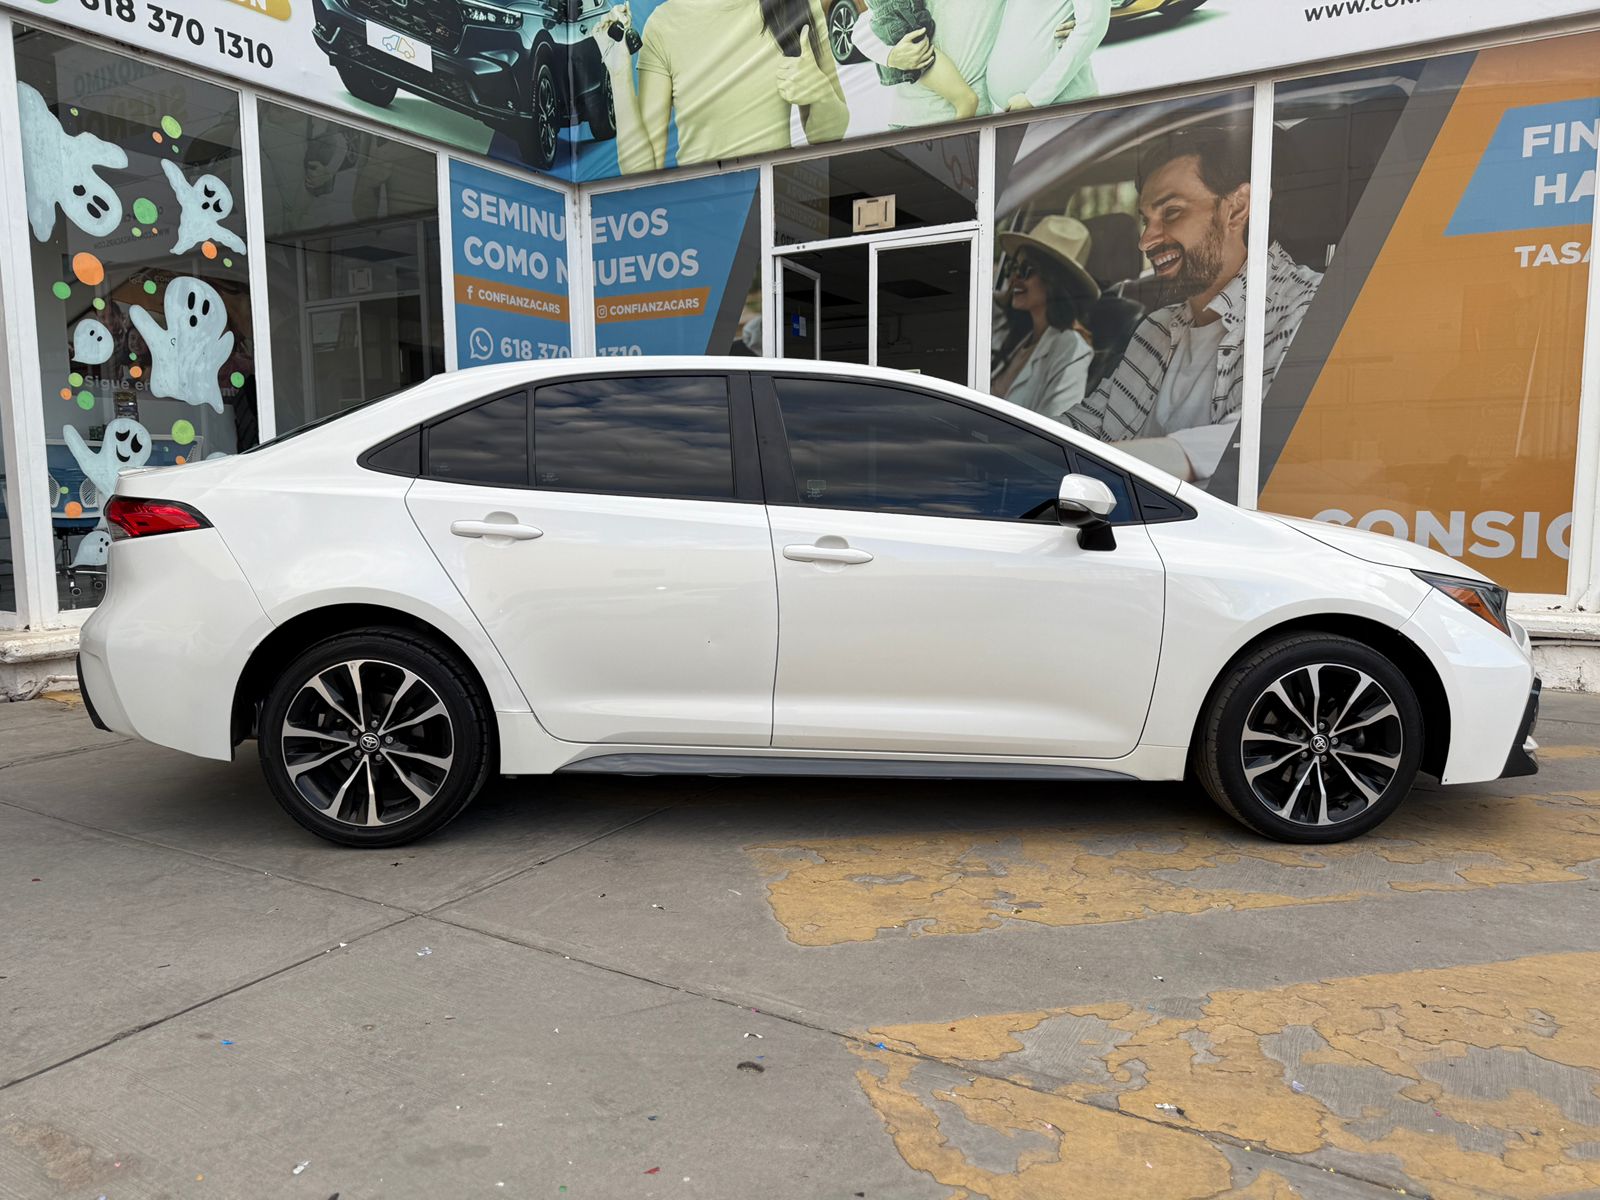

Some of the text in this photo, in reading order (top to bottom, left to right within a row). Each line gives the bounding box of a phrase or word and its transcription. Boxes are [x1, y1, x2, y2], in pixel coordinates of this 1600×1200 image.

[147, 3, 205, 45] 370
[214, 27, 273, 68] 1310
[463, 236, 549, 280] COMO
[478, 289, 561, 314] CONFIANZACARS
[609, 298, 700, 316] CONFIANZACARS
[500, 337, 533, 360] 618
[84, 375, 130, 391] Sigue
[1311, 508, 1573, 559] ONSI
